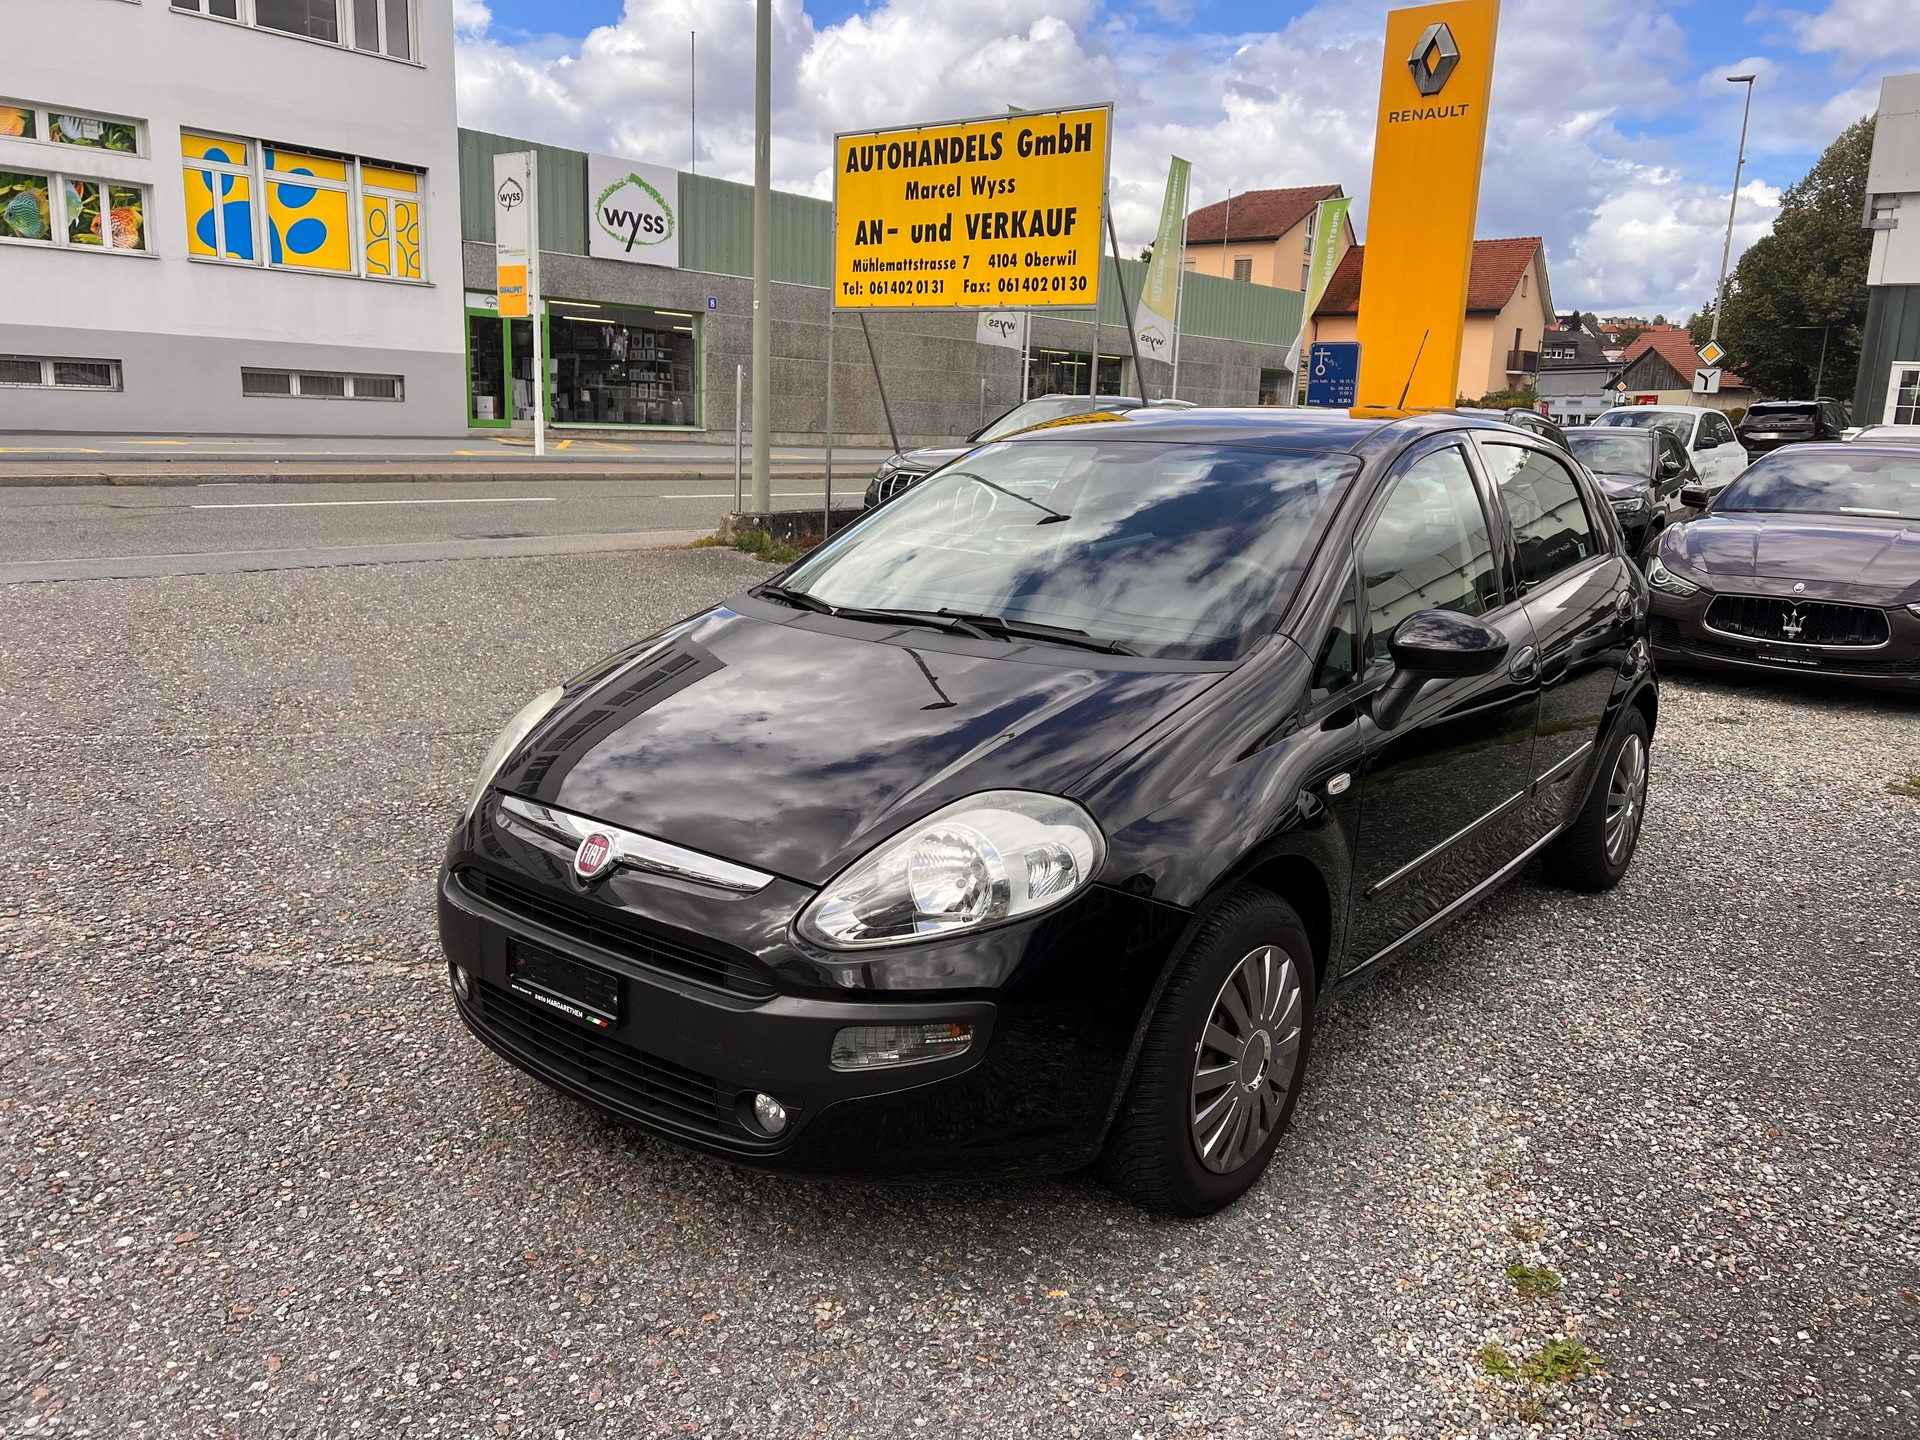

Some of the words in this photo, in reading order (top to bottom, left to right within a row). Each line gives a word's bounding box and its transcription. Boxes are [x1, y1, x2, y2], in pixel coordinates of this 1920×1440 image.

[1388, 104, 1470, 123] RENAULT
[846, 132, 1003, 173] AUTOHANDELS
[1018, 122, 1092, 158] GmbH
[906, 176, 962, 200] Marcel
[970, 175, 1016, 200] Wyss
[500, 192, 520, 212] wyss
[603, 207, 664, 252] wyss
[854, 218, 898, 246] AN-
[911, 212, 952, 244] und
[965, 206, 1078, 241] VERKAUF
[1328, 208, 1340, 244] Traum.
[852, 257, 957, 273] Mühlemattstrasse
[962, 255, 970, 270] 7
[988, 254, 1018, 268] 4104
[1024, 250, 1077, 268] Oberwil
[843, 281, 863, 295] Tel:
[963, 279, 990, 293] Fax:
[580, 842, 606, 866] FIAT
[534, 994, 546, 1002] auto
[546, 998, 583, 1018] MARGARETHEN
